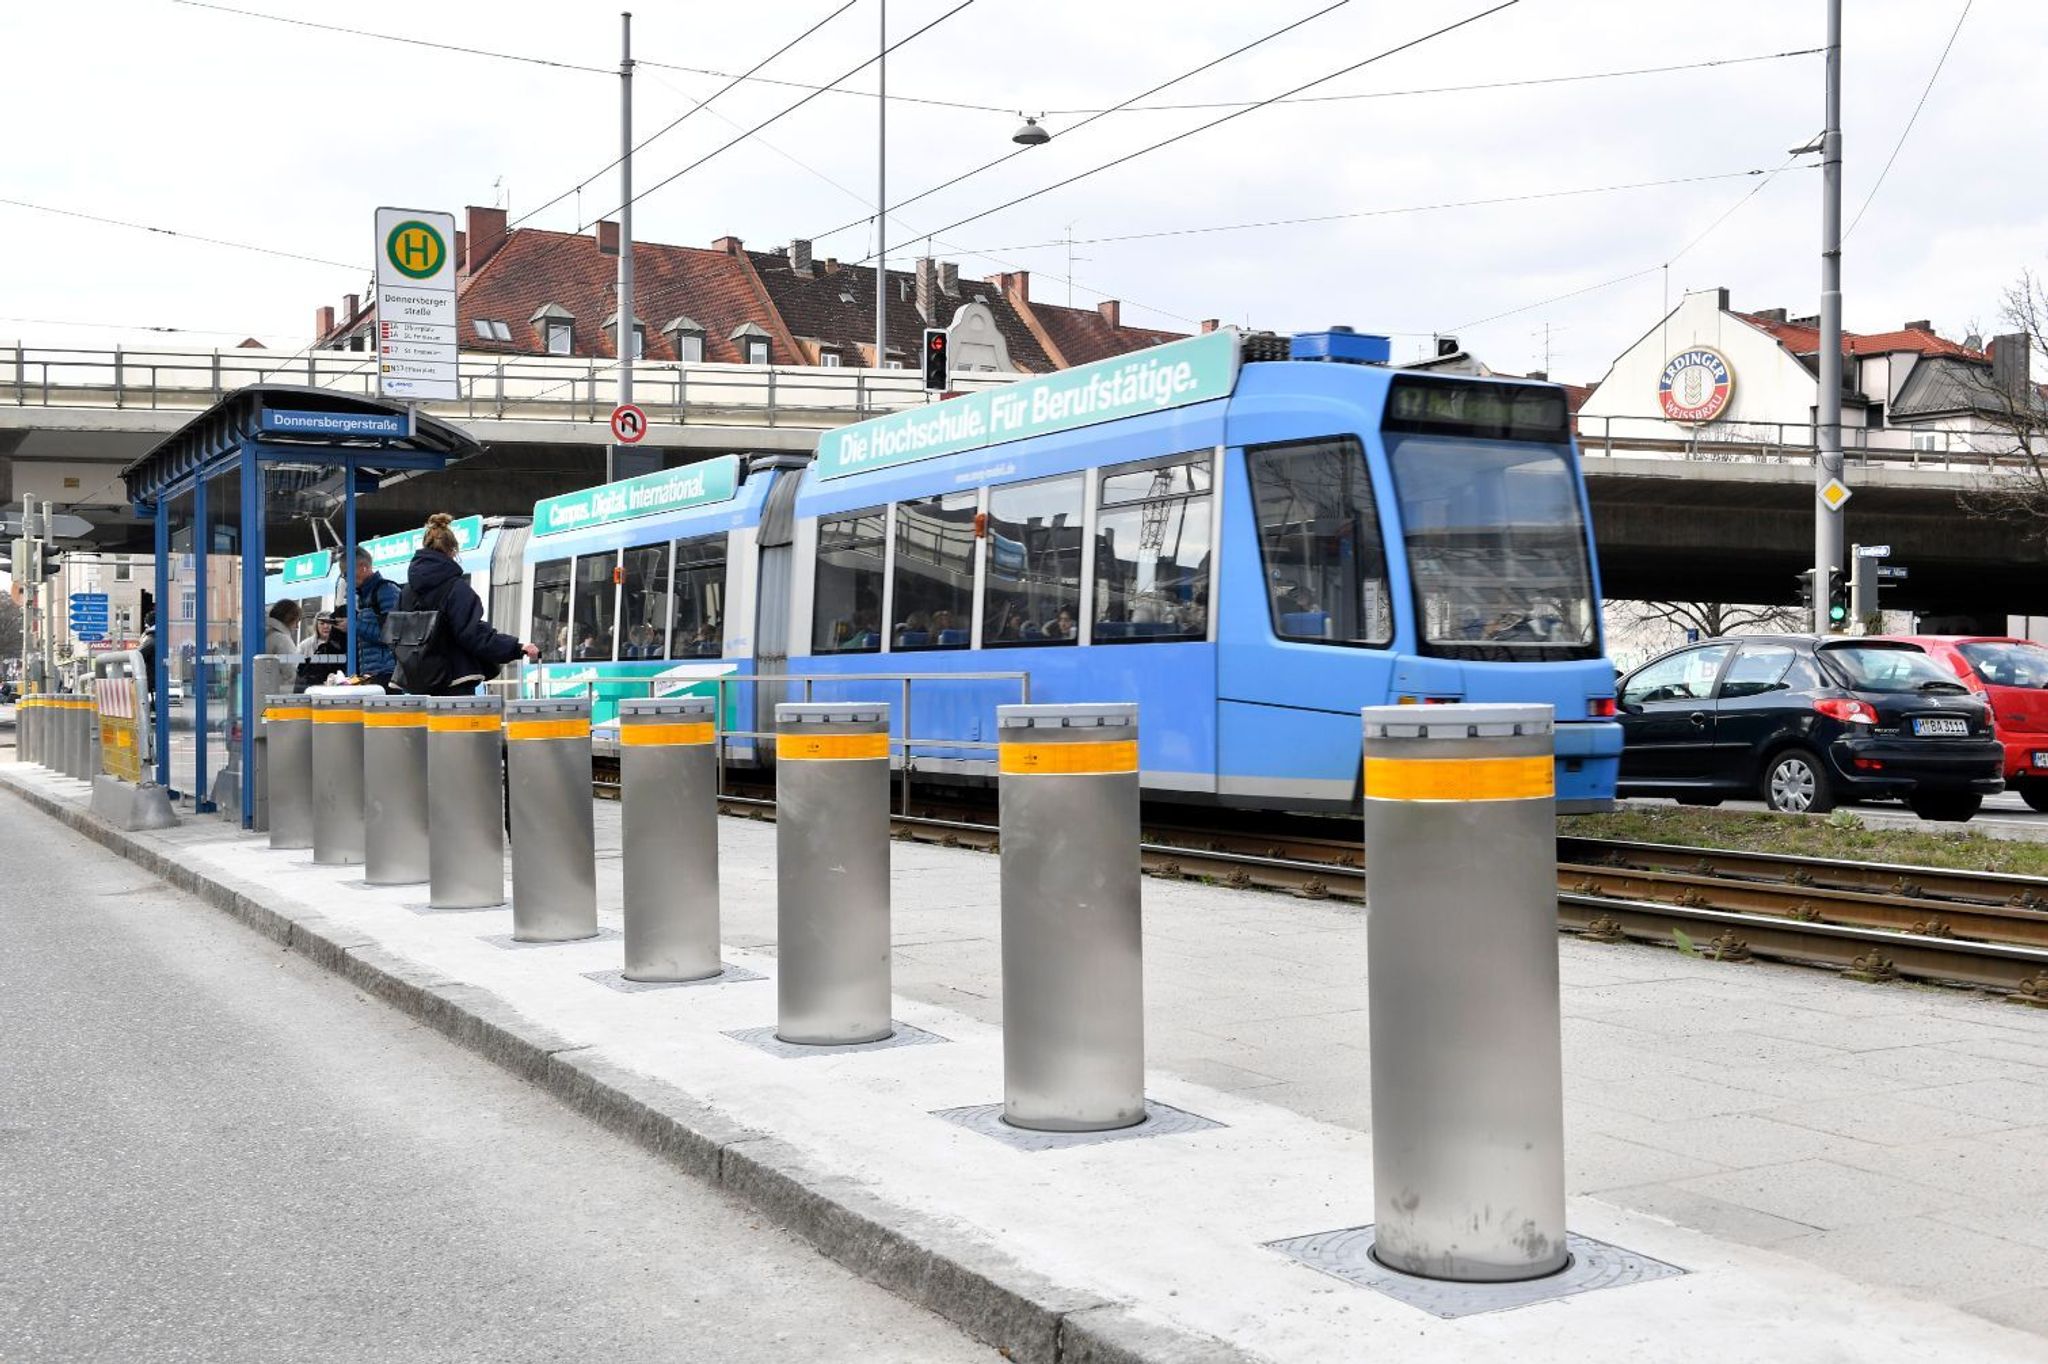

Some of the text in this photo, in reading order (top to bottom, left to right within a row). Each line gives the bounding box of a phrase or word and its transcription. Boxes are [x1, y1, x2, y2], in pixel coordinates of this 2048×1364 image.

[404, 233, 429, 266] H
[1661, 352, 1725, 384] ERDINGER
[273, 414, 399, 432] Donnersbergerstraße
[839, 358, 1197, 465] Die Hochschule. Für Berufstätige.
[591, 489, 628, 520] Digital.
[629, 470, 705, 509] International.
[1944, 719, 1966, 732] 3111
